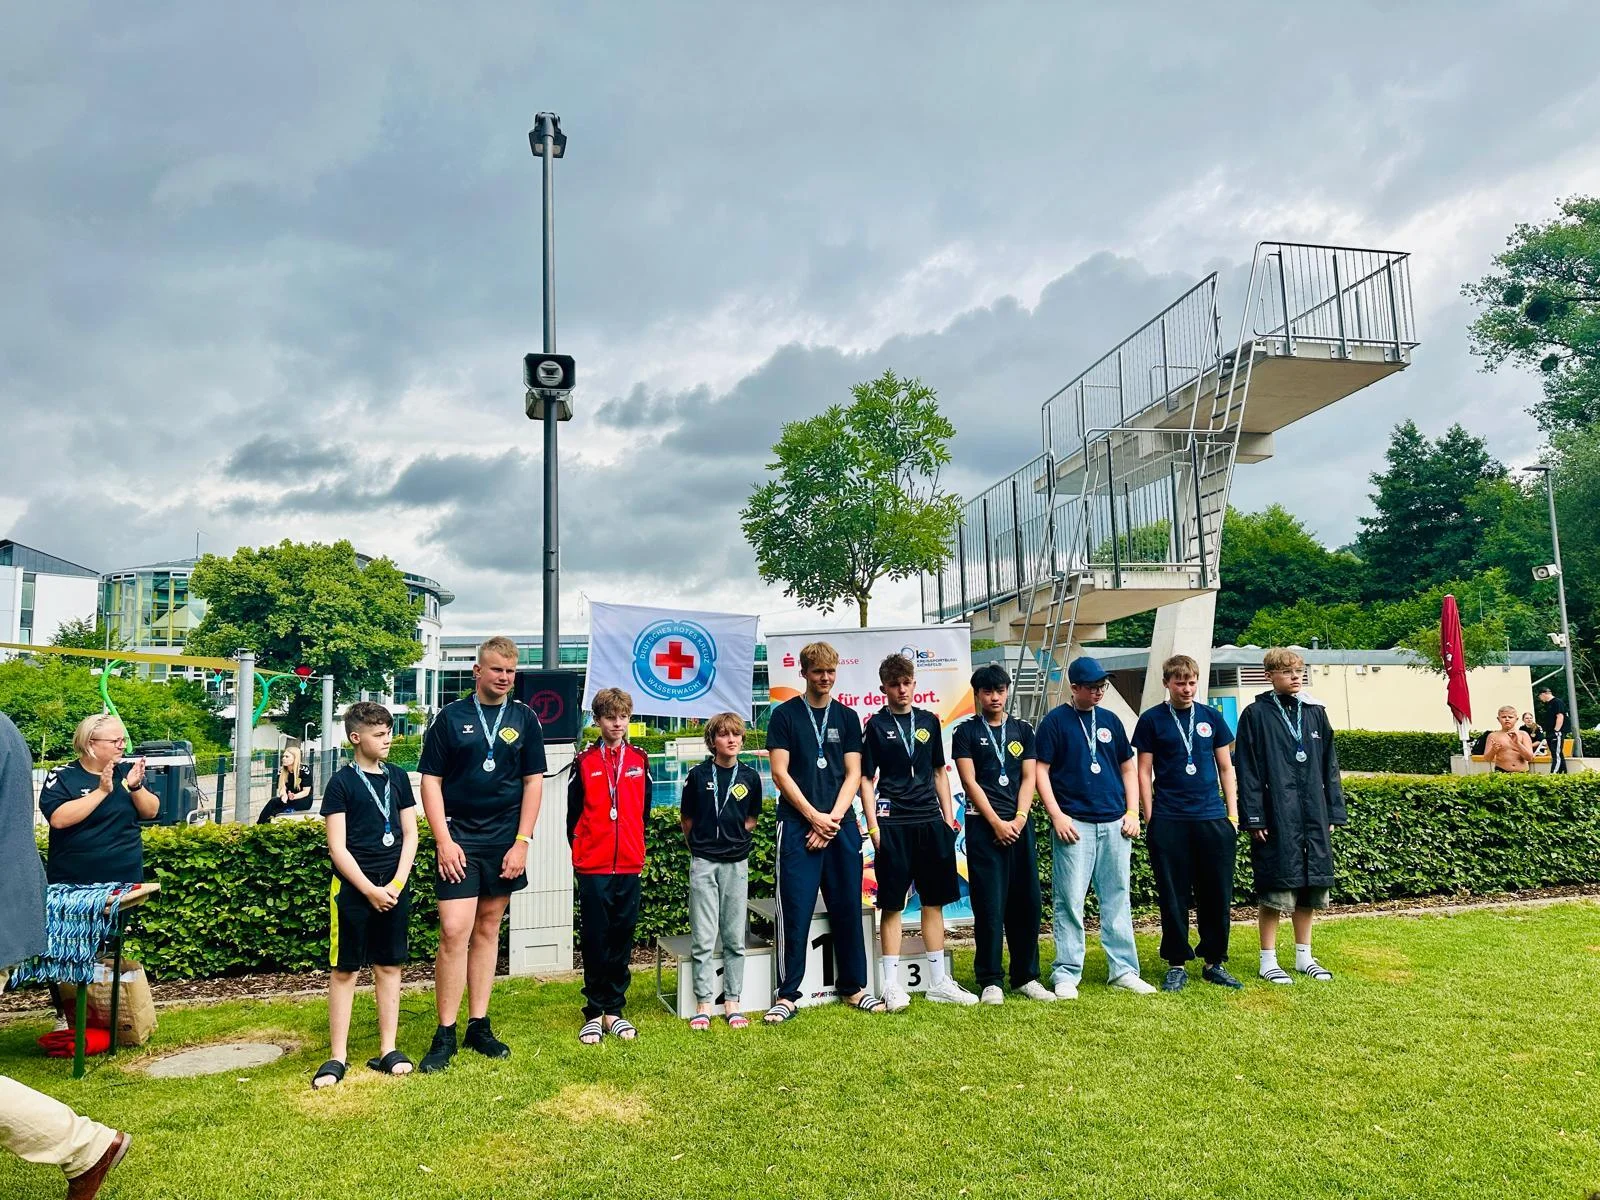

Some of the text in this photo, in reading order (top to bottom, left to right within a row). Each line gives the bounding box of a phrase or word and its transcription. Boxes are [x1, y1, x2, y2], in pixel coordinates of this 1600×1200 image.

[640, 626, 711, 664] DEUTSCHES ROTES KREUZ
[916, 649, 935, 659] ksb
[647, 677, 702, 695] WASSERWACHT
[811, 932, 835, 987] 1
[907, 963, 922, 987] 3
